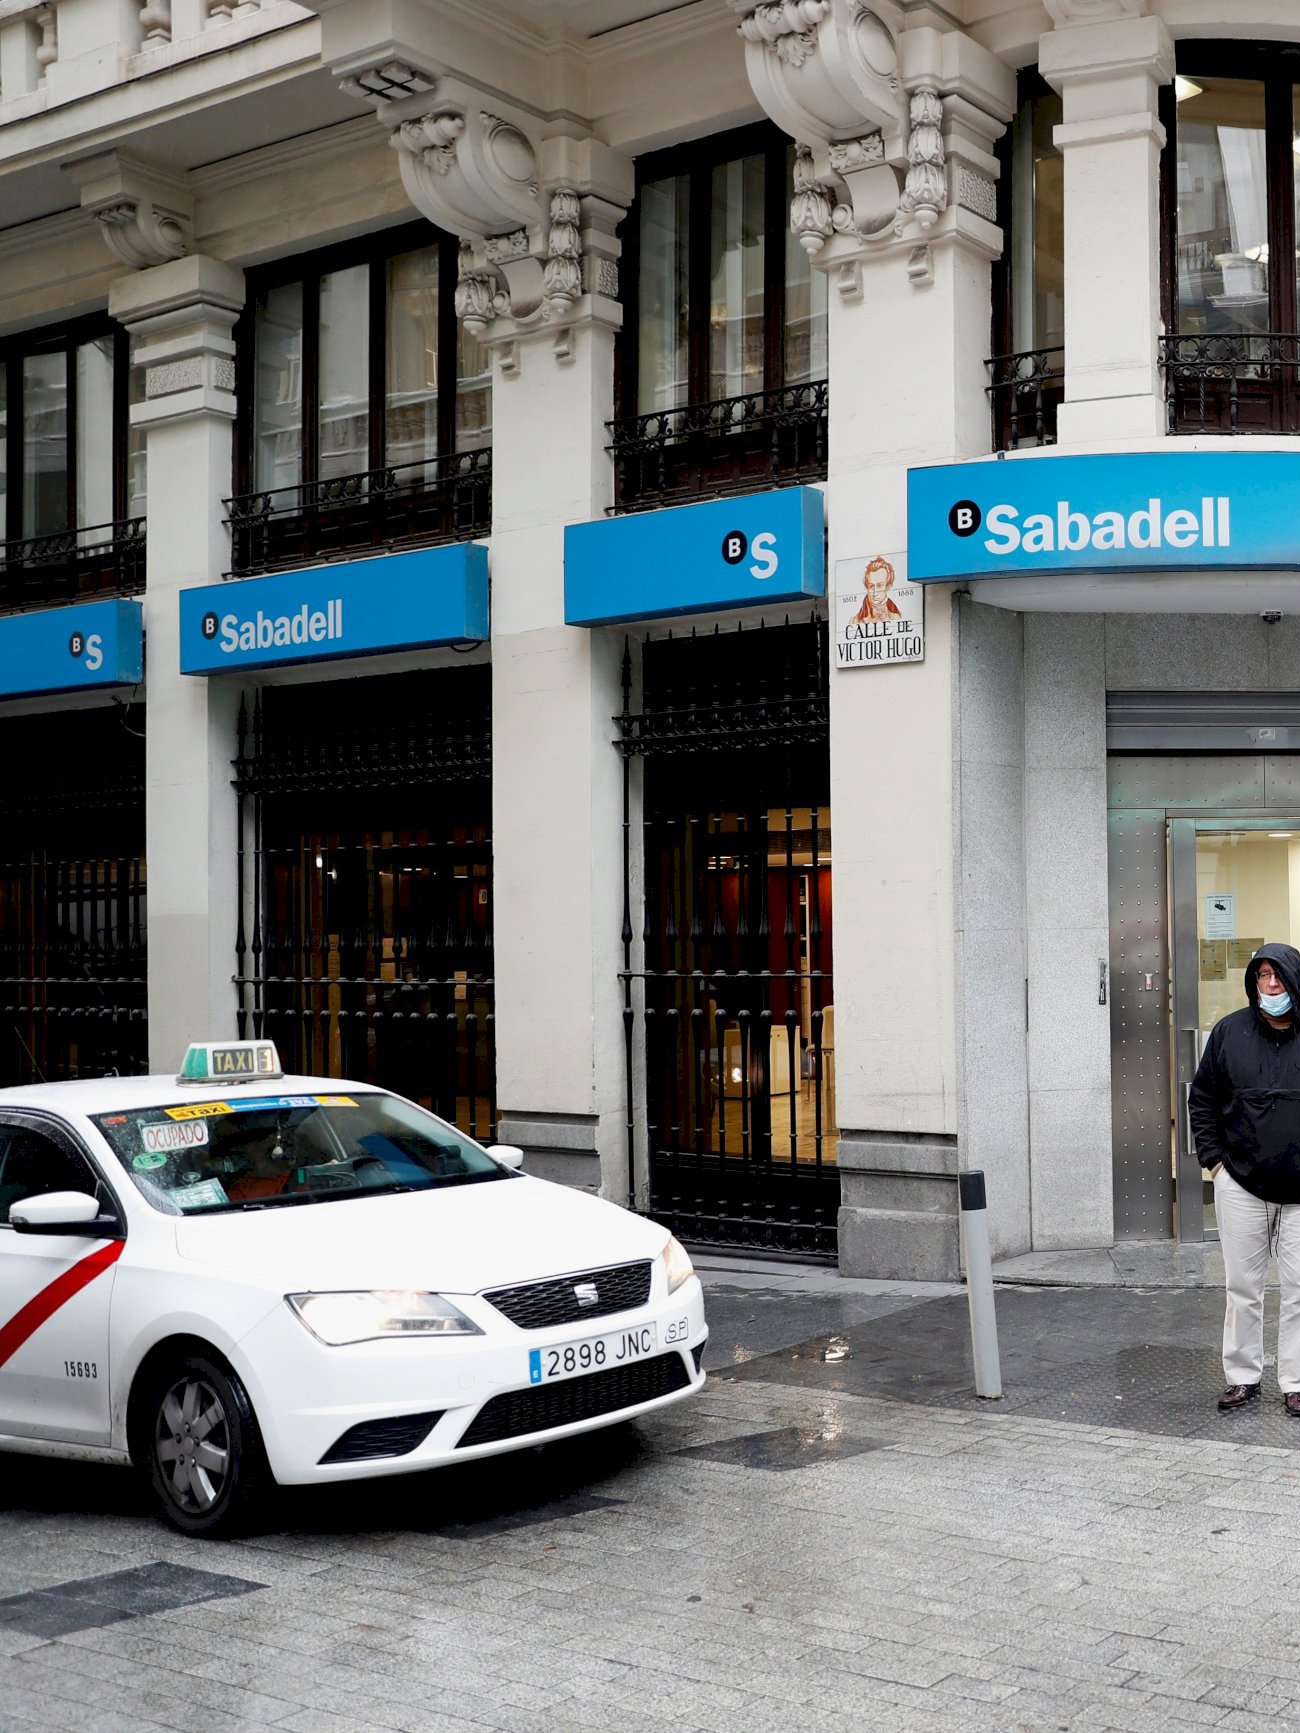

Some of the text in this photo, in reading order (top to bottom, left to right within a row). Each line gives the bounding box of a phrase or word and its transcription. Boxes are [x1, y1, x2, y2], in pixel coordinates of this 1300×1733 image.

[984, 497, 1230, 555] Sabadell
[750, 532, 778, 579] S
[219, 599, 342, 653] Sabadell
[845, 620, 913, 640] CALLE DE
[85, 634, 103, 670] S
[837, 636, 921, 662] VICTOR HUGO
[214, 1051, 253, 1072] TAXI
[147, 1122, 204, 1149] OCUPADO
[668, 1321, 687, 1339] SP
[548, 1340, 606, 1377] 2898
[616, 1329, 651, 1360] JNC
[64, 1361, 97, 1378] 15693
